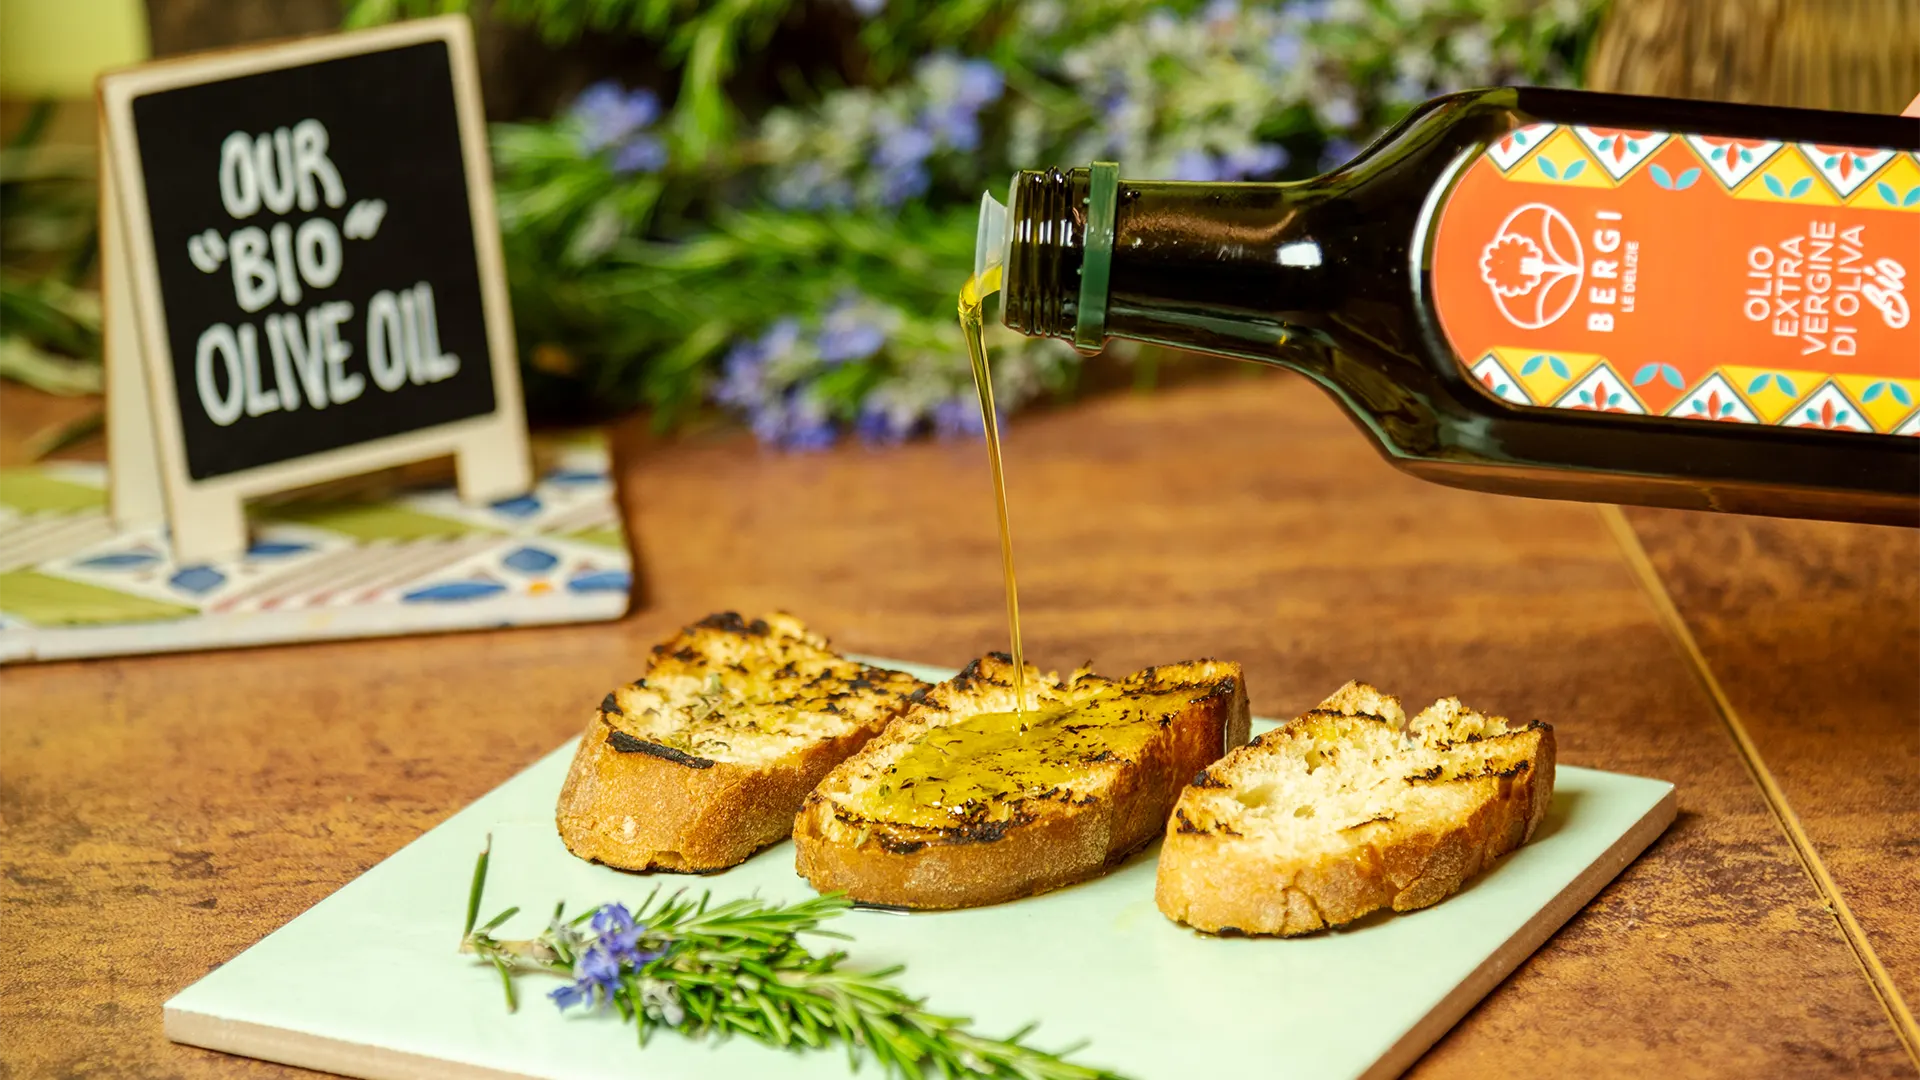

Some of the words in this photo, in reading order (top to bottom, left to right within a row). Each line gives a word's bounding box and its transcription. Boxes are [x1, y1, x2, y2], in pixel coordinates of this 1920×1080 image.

[219, 118, 346, 219] OUR
[1587, 210, 1623, 332] BERGI
[1621, 296, 1635, 312] LE
[1622, 241, 1639, 293] DELIZIE
[1744, 246, 1775, 321] OLIO
[1772, 236, 1805, 337] EXTRA
[1801, 221, 1836, 356] VERGINE
[1833, 225, 1866, 317] OLIVA
[1861, 258, 1910, 329] Bio
[195, 301, 366, 426] OLIVE
[366, 281, 460, 392] OIL
[1830, 326, 1858, 356] DI
